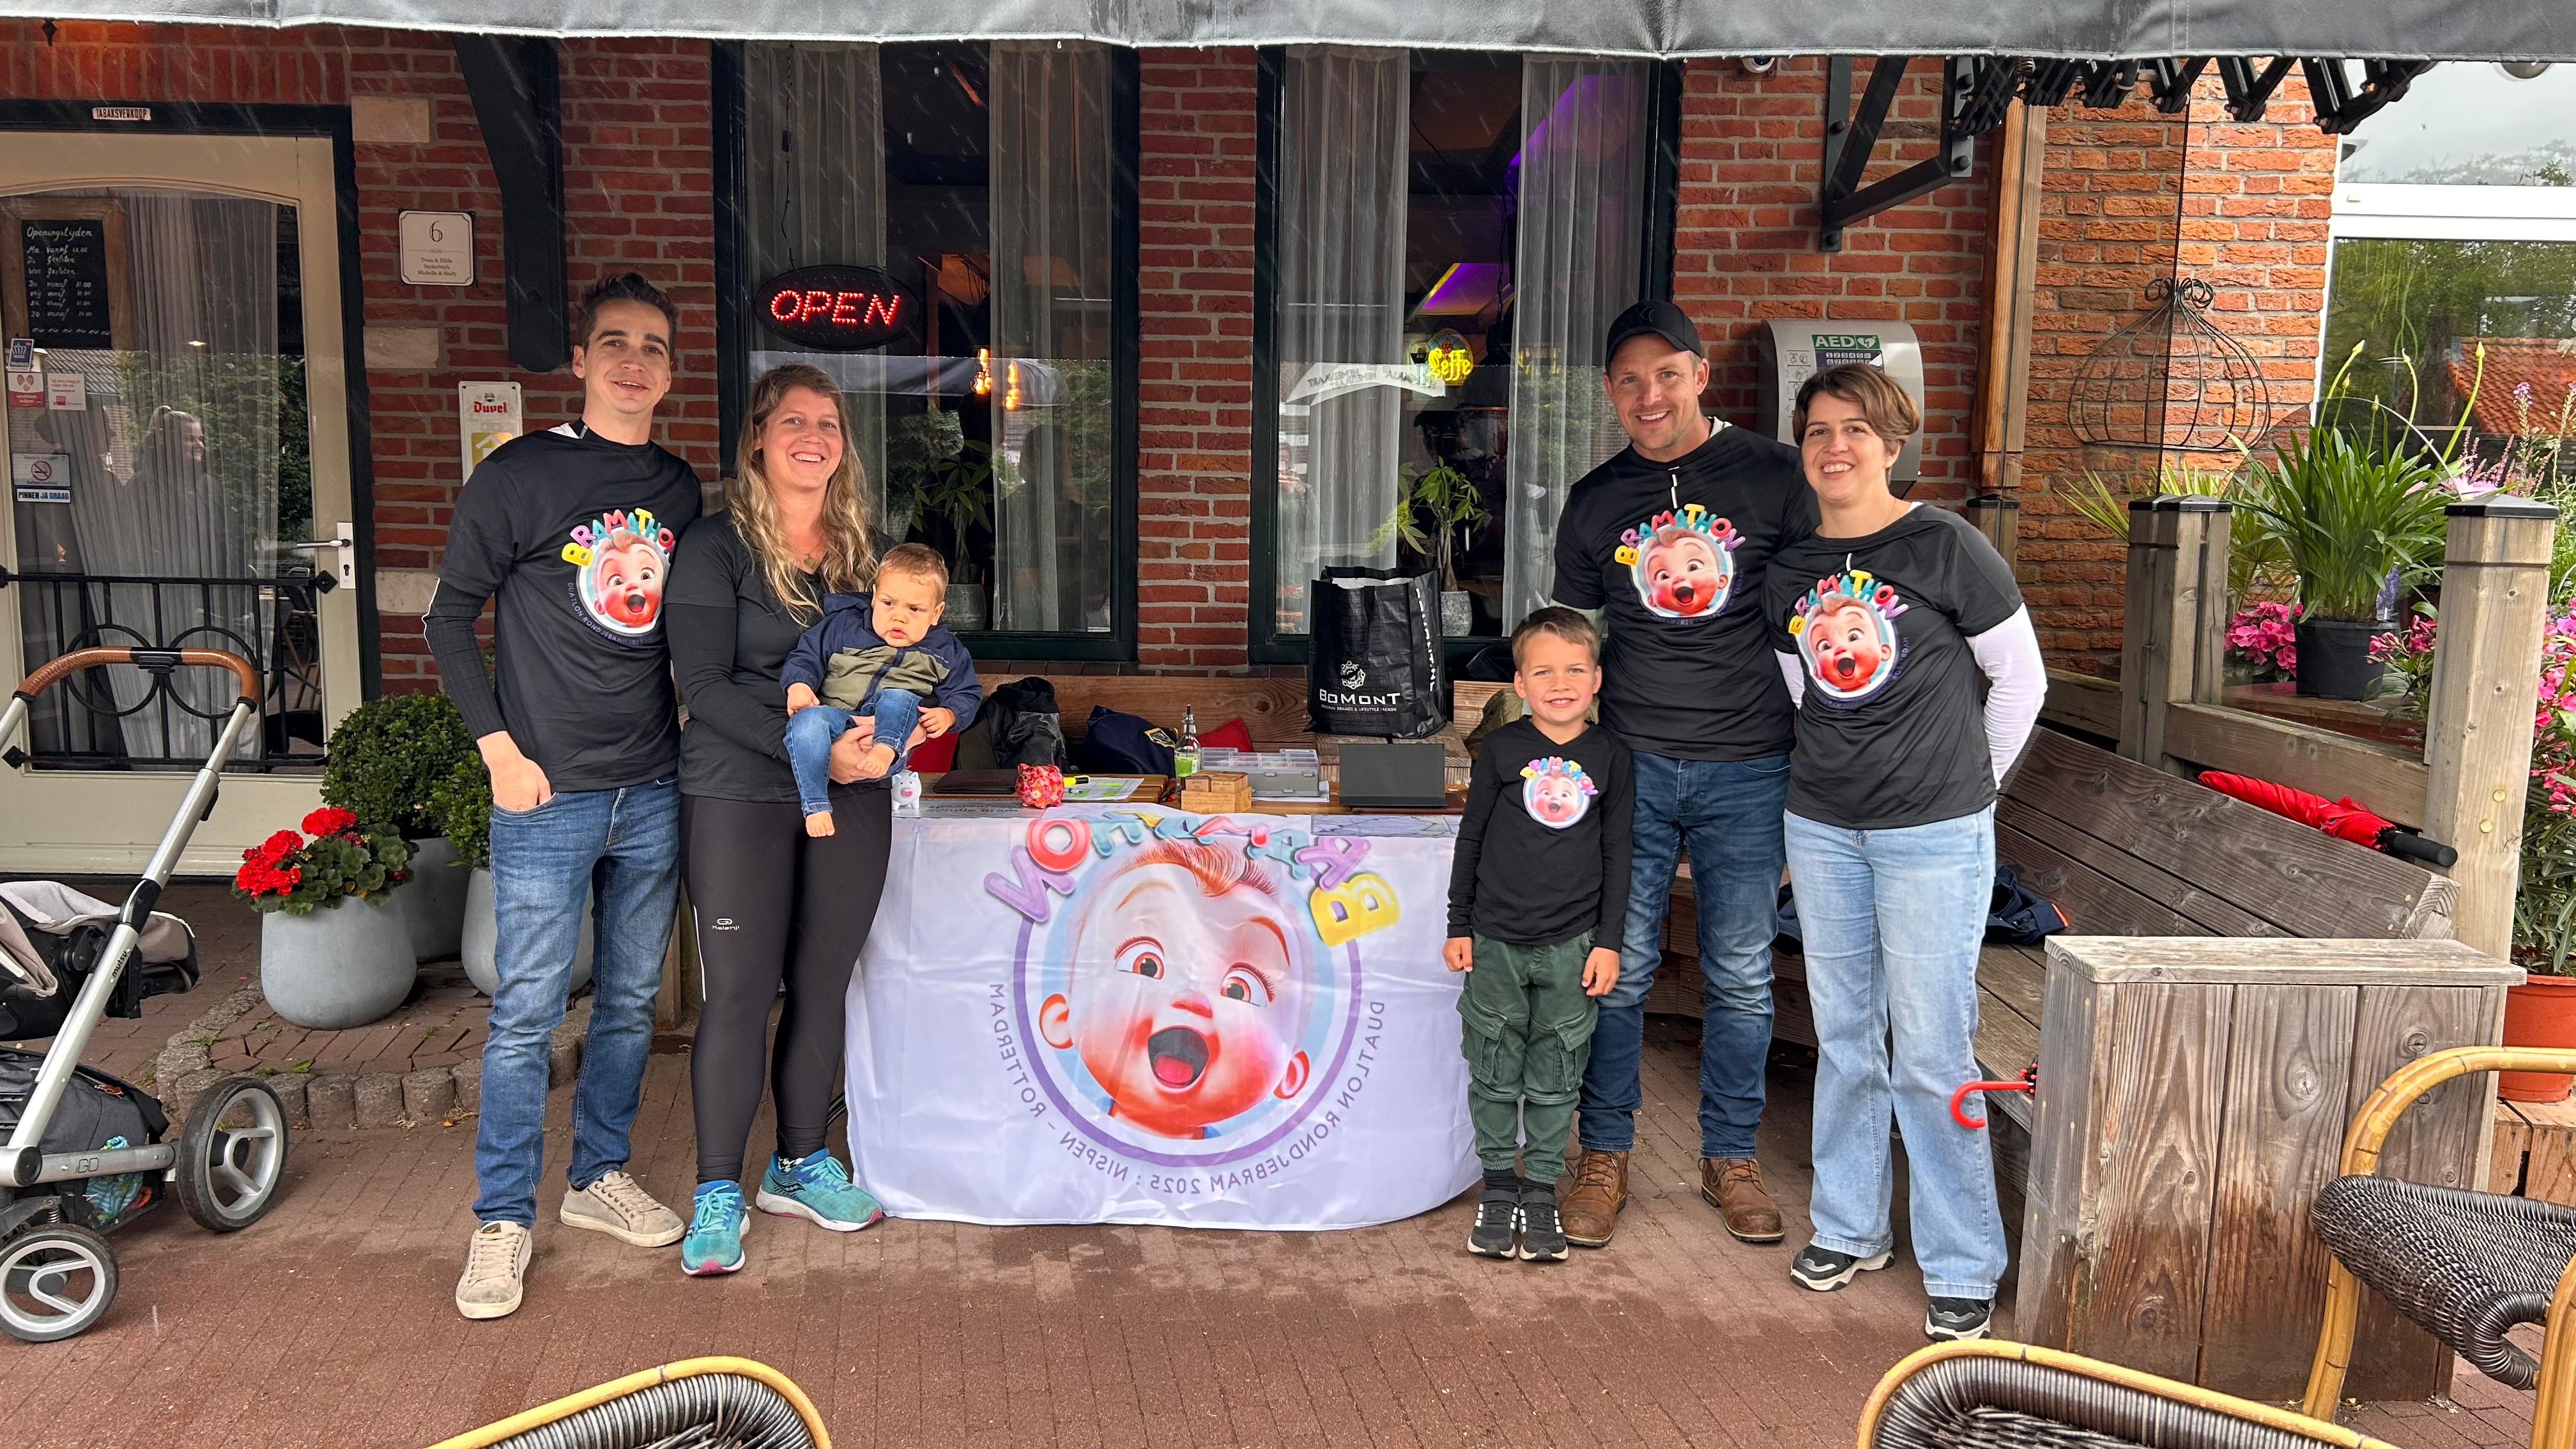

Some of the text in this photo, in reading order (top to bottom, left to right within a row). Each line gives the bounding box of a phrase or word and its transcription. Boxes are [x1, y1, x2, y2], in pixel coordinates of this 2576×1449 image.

[96, 108, 147, 119] TABAKSVERKOOP
[429, 220, 443, 243] 6
[770, 289, 900, 326] OPEN
[1815, 335, 1855, 348] AED
[1426, 347, 1473, 381] Leffe
[473, 400, 508, 413] Duvel
[1614, 503, 1746, 566] BRAMATHON
[567, 582, 583, 617] DUATLON
[1788, 569, 1908, 635] BRAMATHON
[112, 950, 127, 977] mutsy
